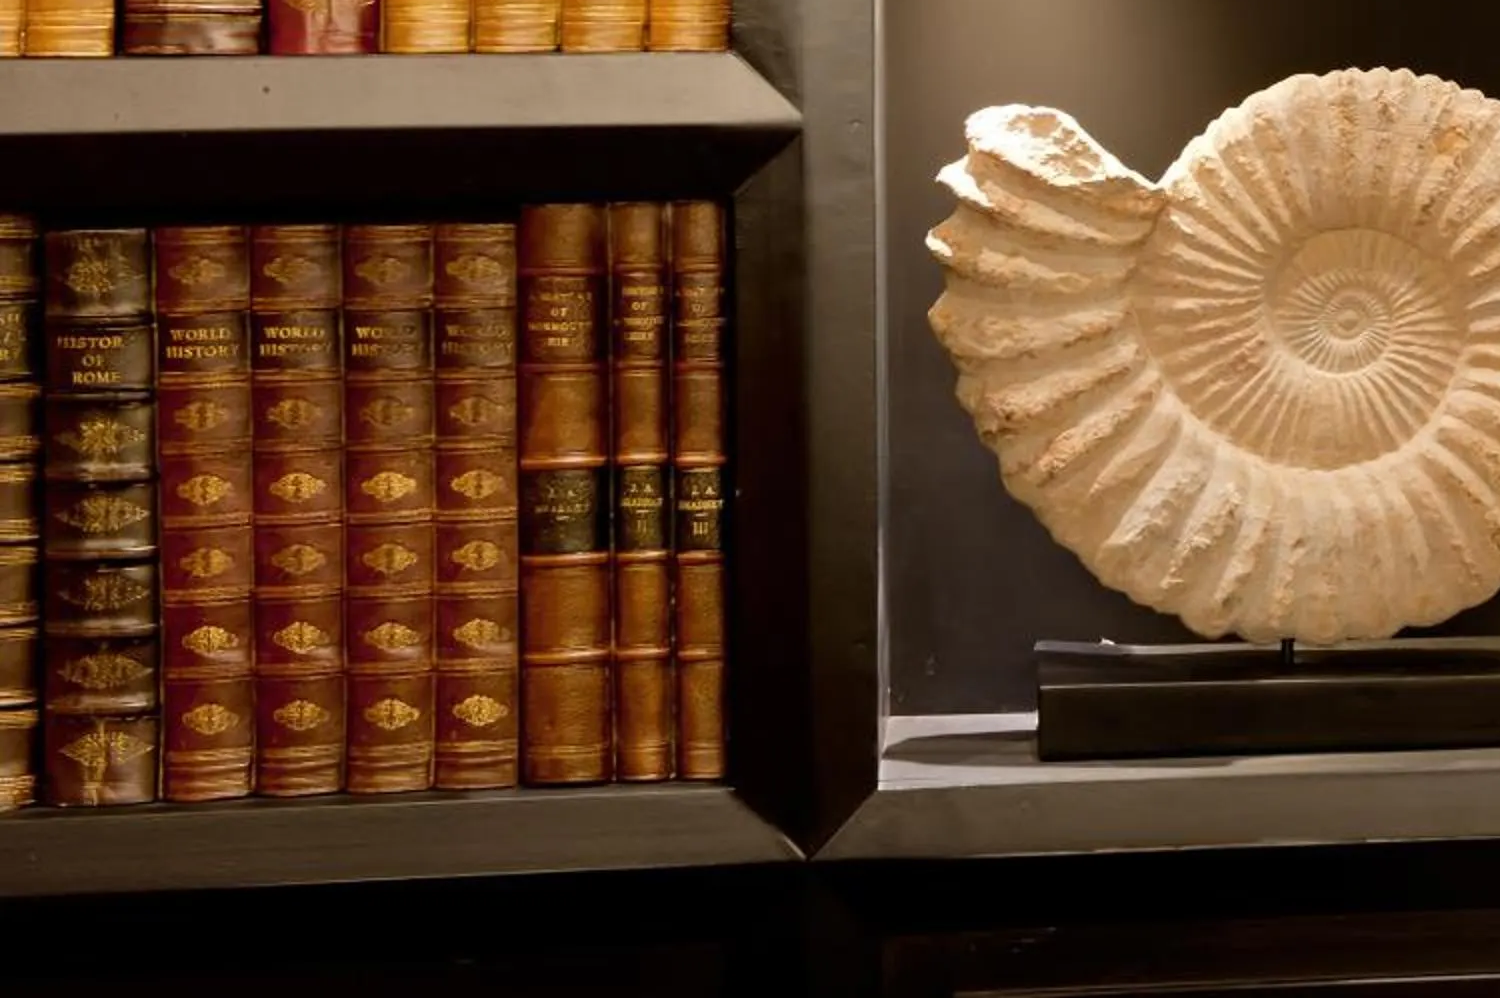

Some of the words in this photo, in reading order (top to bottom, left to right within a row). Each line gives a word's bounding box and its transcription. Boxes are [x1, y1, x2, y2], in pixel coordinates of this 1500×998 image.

[170, 327, 232, 342] WORLD
[263, 325, 326, 340] WORLD
[57, 335, 125, 349] HISTOR
[165, 343, 240, 360] HISTORY
[73, 370, 122, 385] ROME
